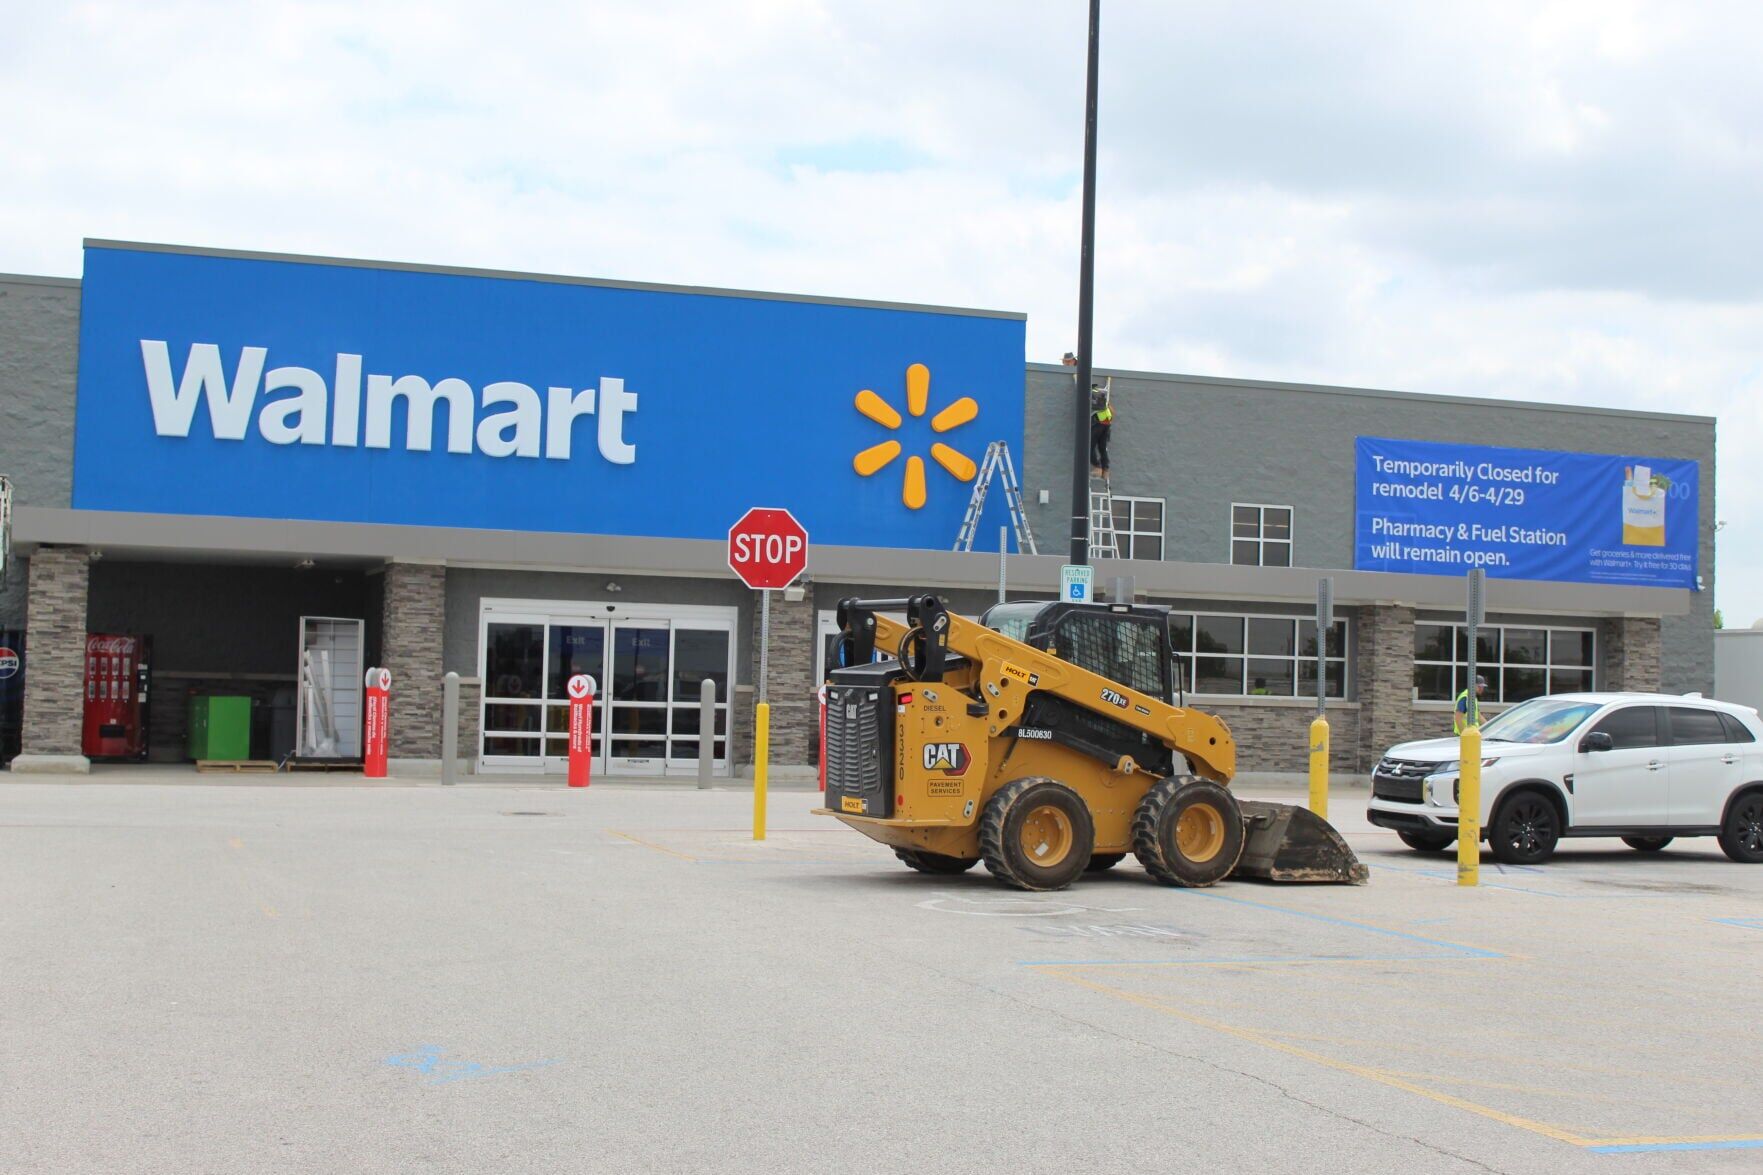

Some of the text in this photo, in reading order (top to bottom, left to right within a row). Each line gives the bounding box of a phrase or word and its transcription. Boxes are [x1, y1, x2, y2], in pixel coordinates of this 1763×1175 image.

[140, 339, 638, 465] Walmart
[1372, 456, 1559, 484] Temporarily Closed for
[1372, 482, 1524, 506] remodel 4/6-4/29
[1372, 518, 1566, 546] Pharmacy & Fuel Station
[734, 534, 802, 564] STOP
[1372, 542, 1510, 566] will remain open.
[1590, 548, 1600, 557] Get
[1602, 550, 1628, 559] groceries
[566, 636, 585, 644] Exit
[632, 638, 650, 646] Exit
[1006, 666, 1026, 678] HOLT
[1101, 688, 1120, 704] 270
[846, 704, 858, 719] CAT
[924, 744, 960, 769] CAT
[844, 801, 859, 809] HOLT
